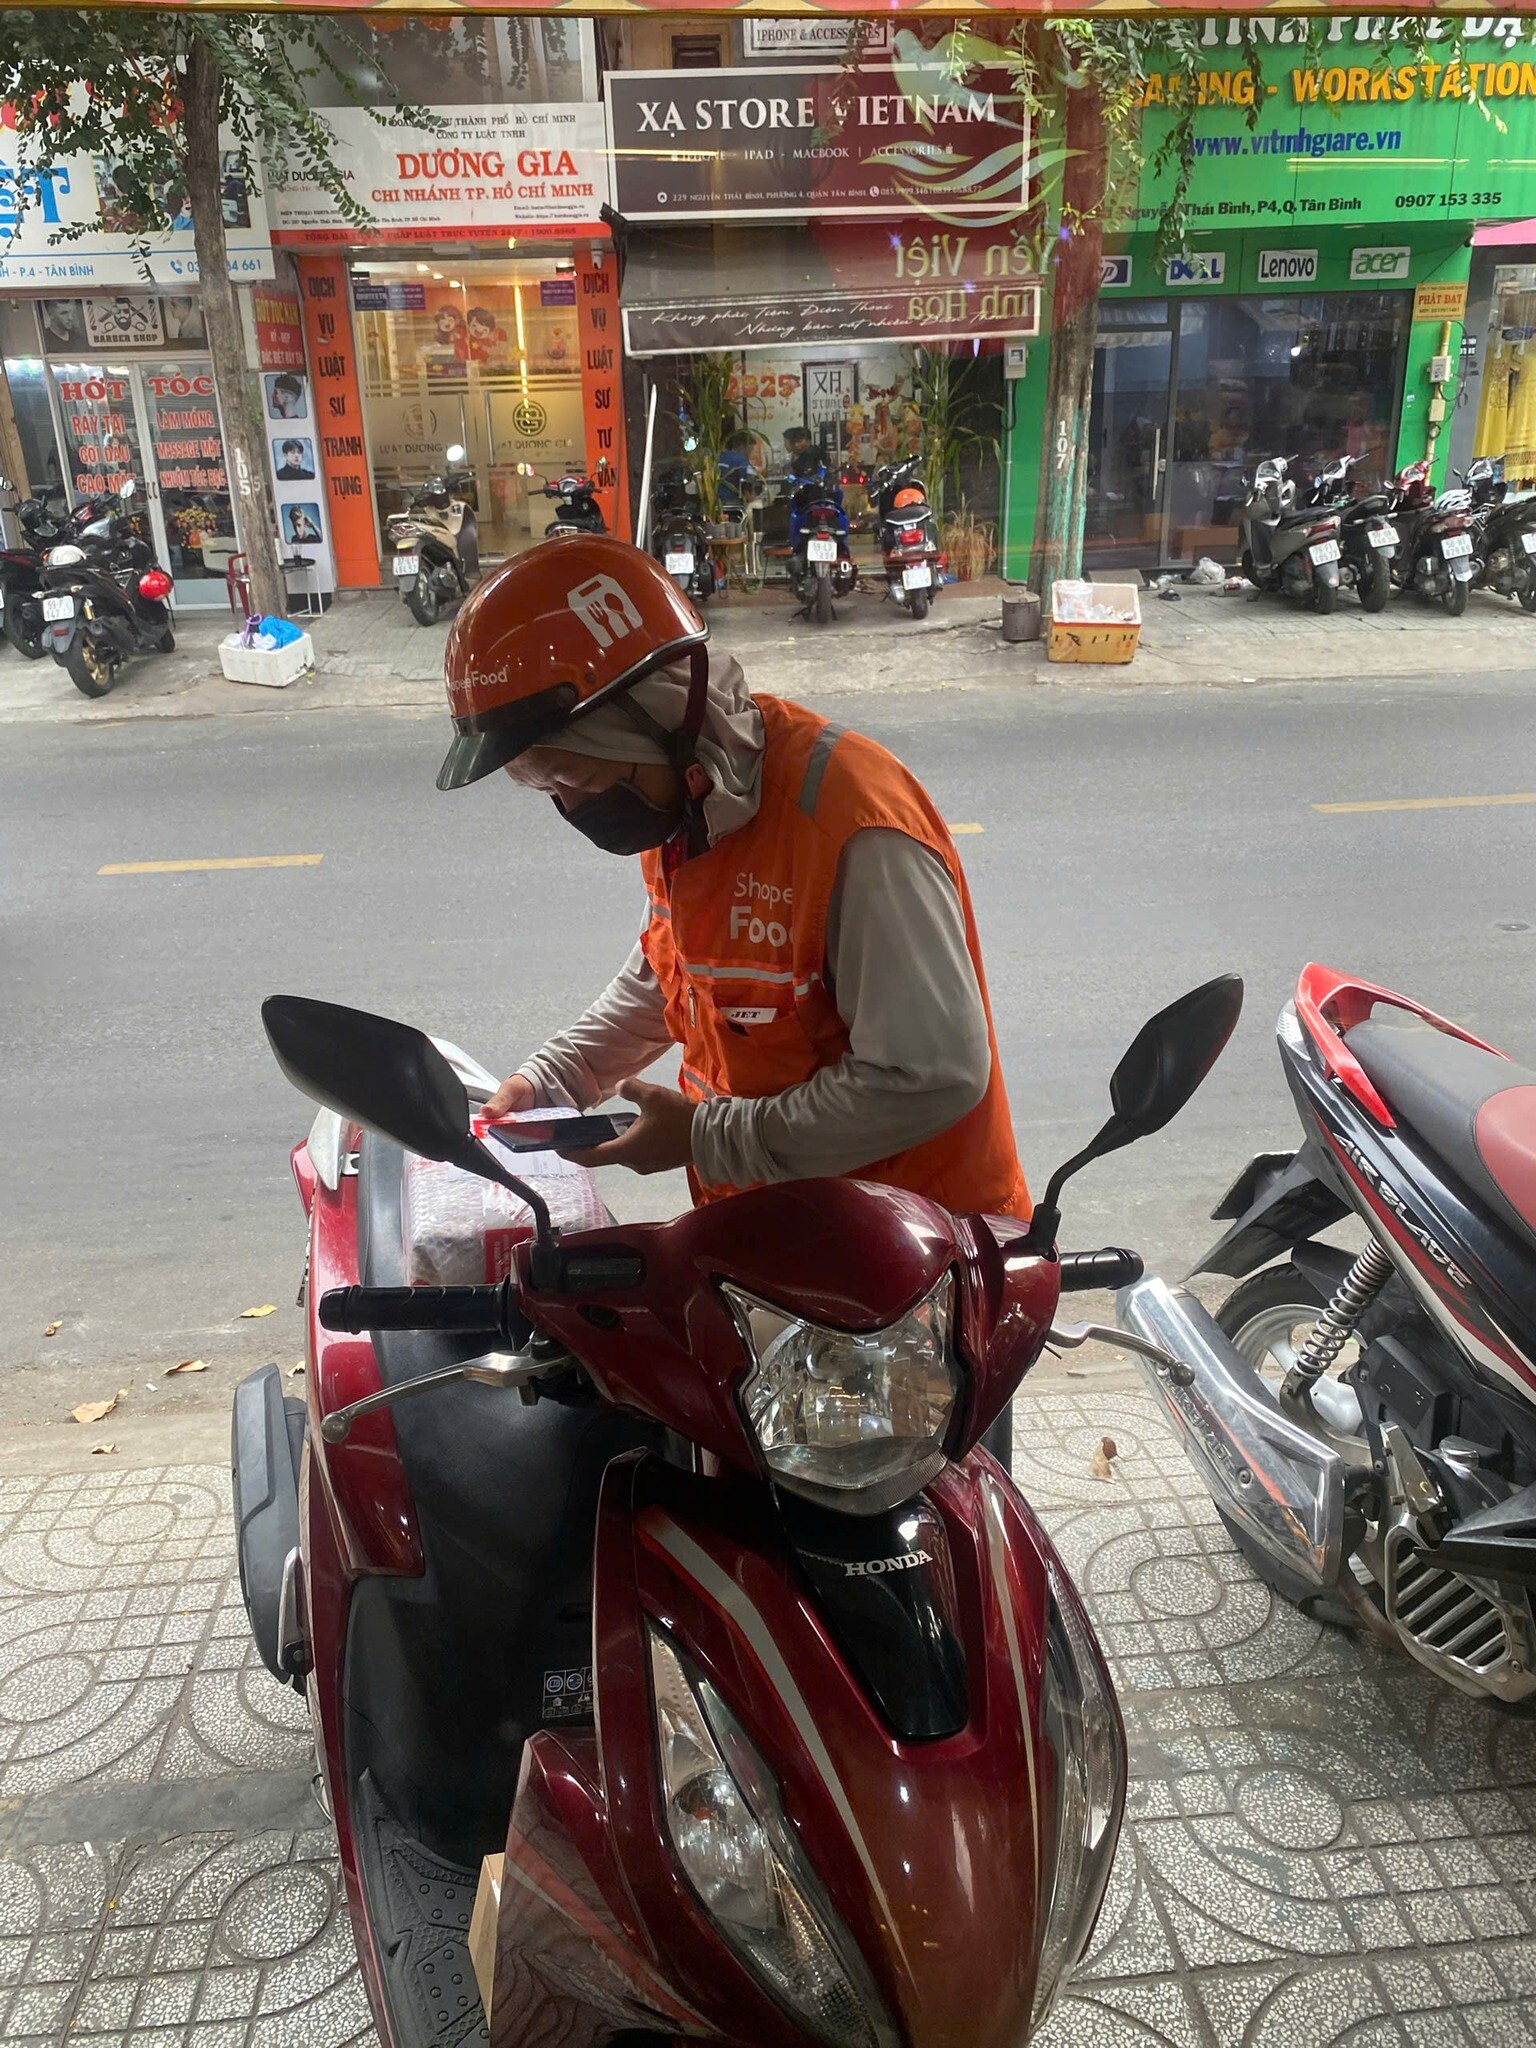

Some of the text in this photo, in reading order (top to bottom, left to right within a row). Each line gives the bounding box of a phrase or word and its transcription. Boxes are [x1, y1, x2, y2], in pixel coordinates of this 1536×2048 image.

[757, 29, 796, 41] IPHONE
[800, 29, 808, 40] &
[1292, 61, 1536, 103] WORKSTATION
[455, 114, 487, 126] THÀNH
[492, 114, 509, 126] PHỐ
[532, 114, 549, 124] CHÍ
[553, 114, 576, 123] MINH
[636, 101, 687, 138] XẠ
[695, 97, 815, 131] STORE
[462, 131, 473, 139] TY
[501, 129, 526, 139] TNHH
[396, 148, 578, 179] DƯƠNG GIA
[744, 149, 774, 160] IPAD
[792, 147, 850, 159] MACBOOK
[871, 144, 943, 157] ACCESSORIES
[371, 180, 594, 203] CHI NHÁNH TP. HỒ CHÍ MINH
[1218, 201, 1255, 216] Bình,
[1301, 198, 1326, 212] Tân
[1329, 197, 1362, 212] Bình
[1395, 195, 1435, 208] 0907
[1439, 194, 1468, 207] 153
[1472, 192, 1503, 205] 335
[45, 263, 67, 276] TÂN
[69, 263, 94, 276] BÌNH
[243, 259, 261, 271] 661
[1260, 253, 1315, 278] Lenovo
[1354, 251, 1406, 275] acer
[308, 276, 335, 301] DỊCH
[583, 273, 609, 297] DỊCH
[318, 313, 335, 339] VỤ
[591, 308, 607, 331] VỤ
[94, 333, 158, 343] BARBER SHOP
[318, 352, 346, 380] LUẬT
[587, 345, 614, 373] LUẬT
[60, 376, 128, 401] HỚT
[149, 372, 214, 397] TÓC
[595, 388, 611, 409] SƯ
[102, 413, 126, 435] TAI
[156, 440, 200, 459] MASSAGE
[324, 436, 363, 457] TRANH
[597, 427, 612, 449] TƯ
[1056, 420, 1067, 470] 107
[331, 476, 362, 500] TỤNG
[730, 1010, 760, 1019] JET
[844, 1550, 933, 1577] HONDA
